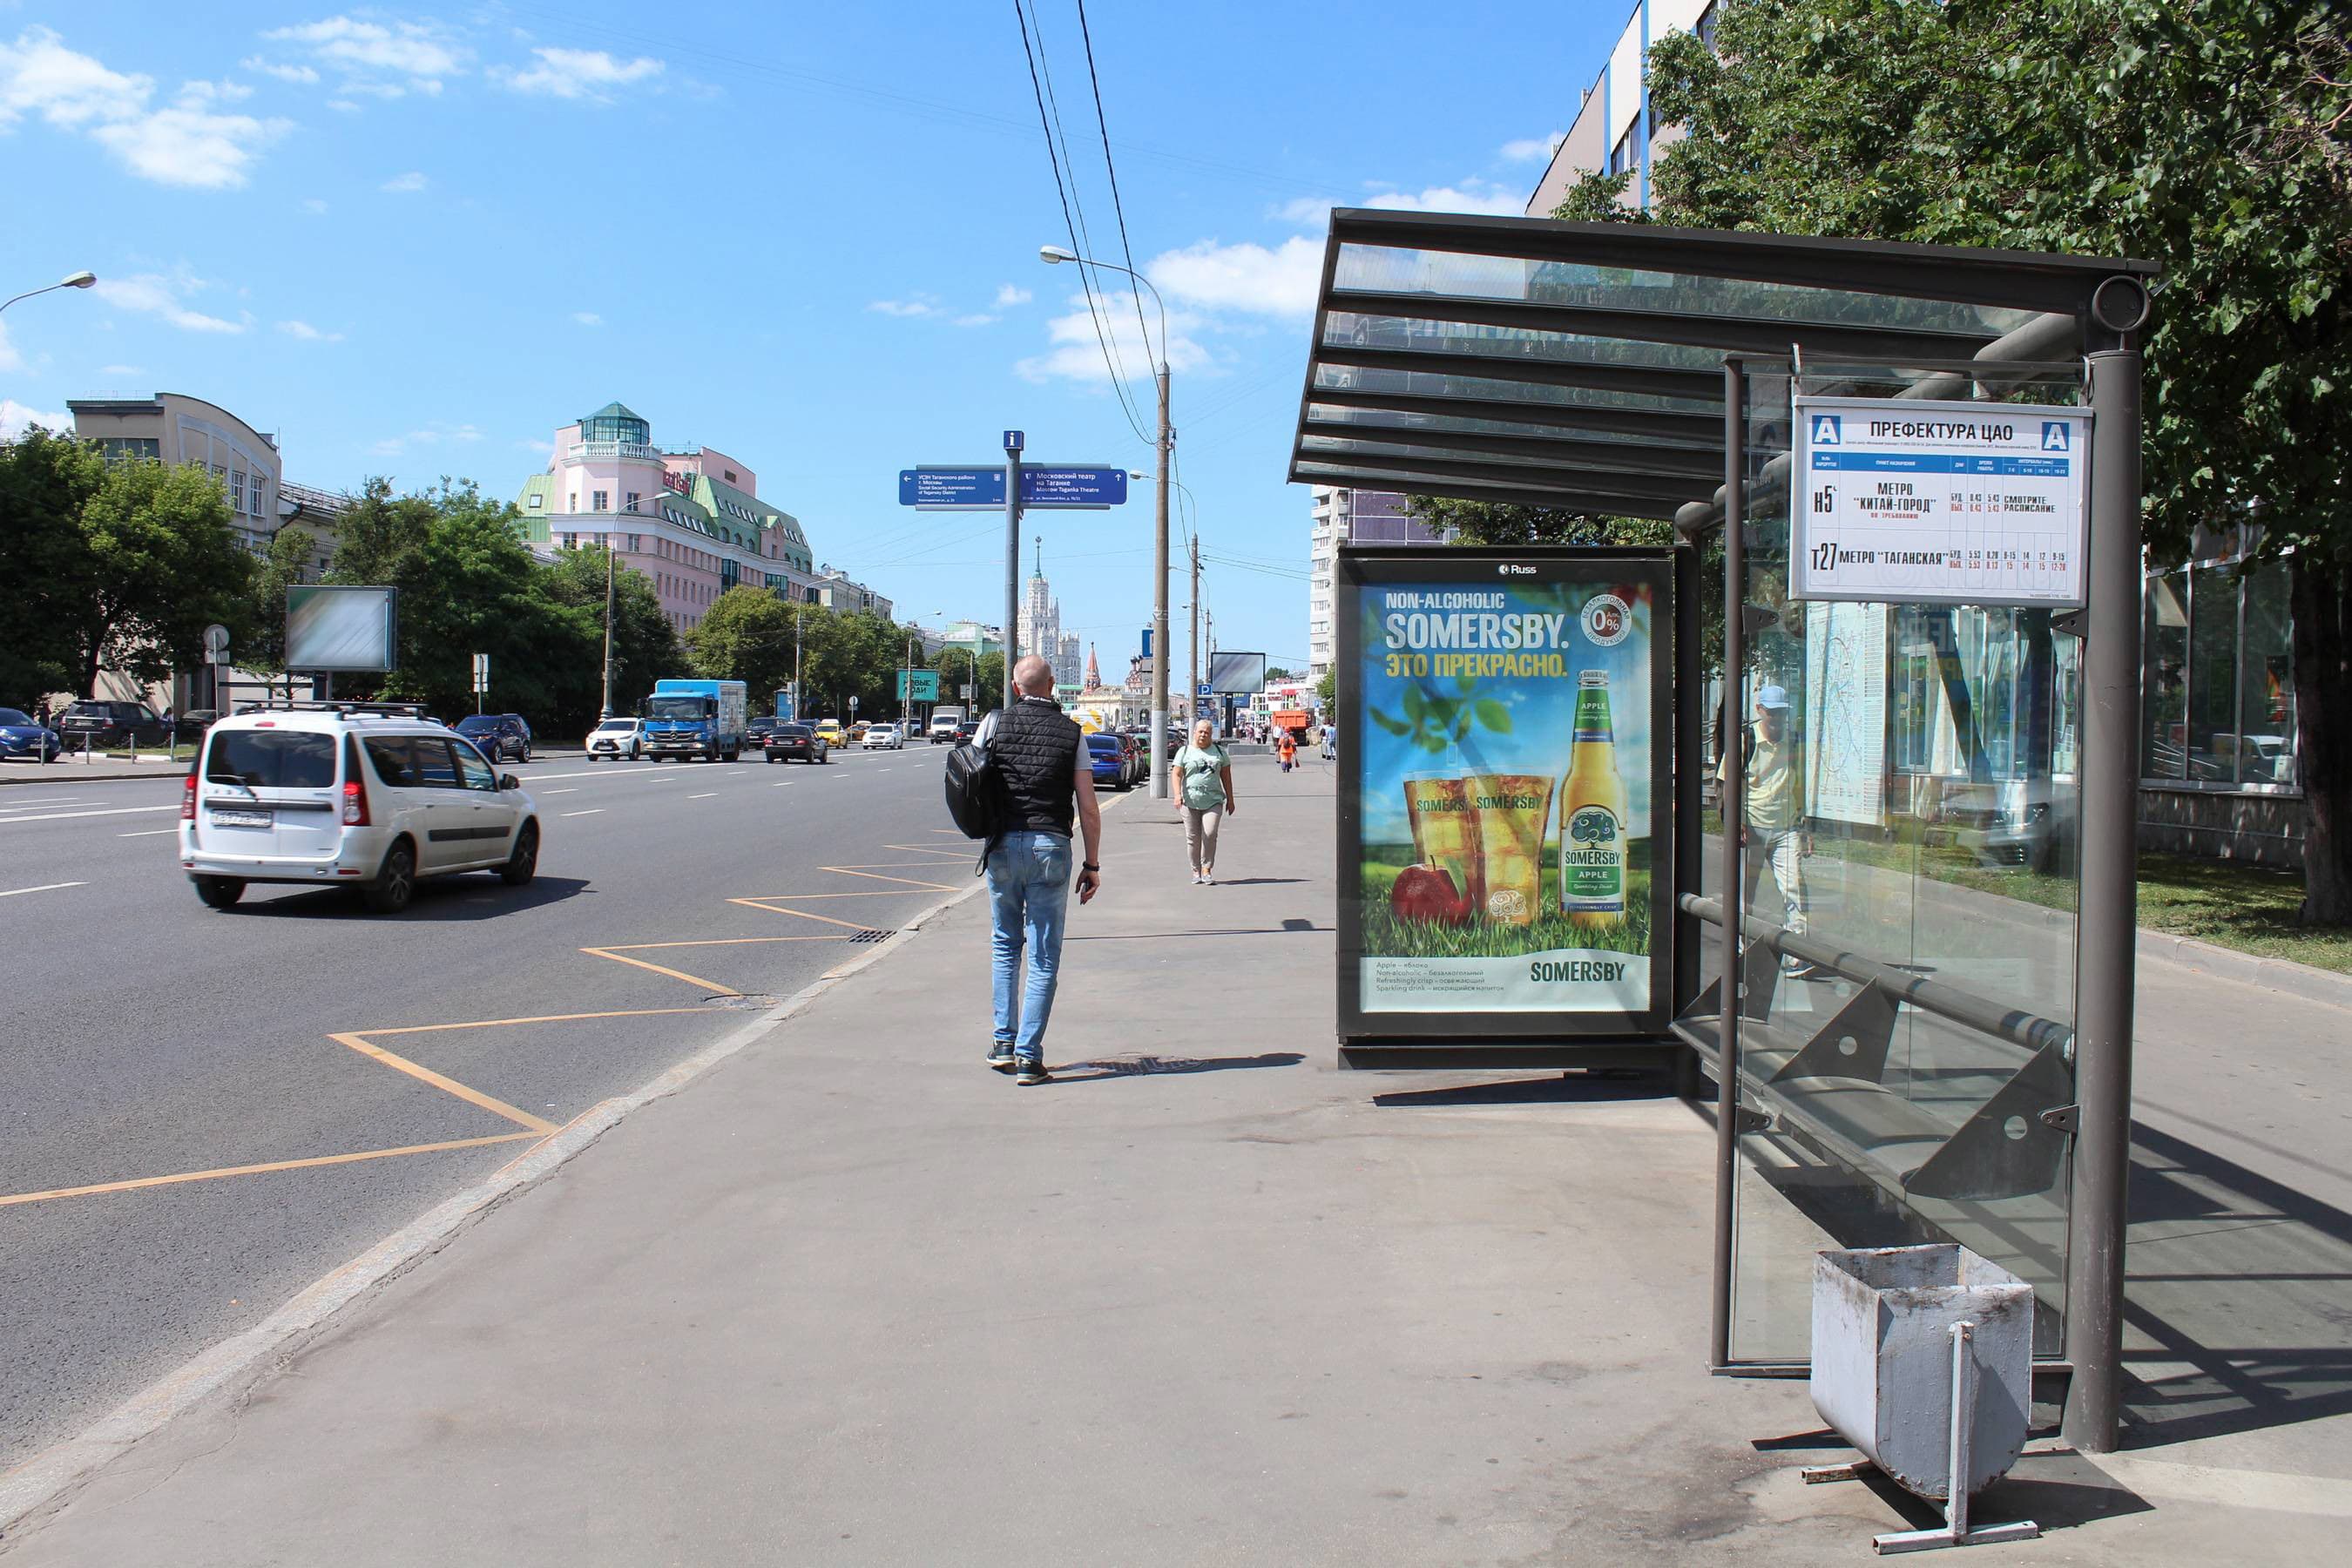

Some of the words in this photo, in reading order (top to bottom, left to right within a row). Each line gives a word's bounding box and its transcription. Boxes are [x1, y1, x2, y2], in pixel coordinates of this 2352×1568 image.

[1870, 422, 1977, 439] ПРЕФЕКТУРА
[1982, 424, 2013, 443] ЦАО
[1878, 483, 1913, 496] МЕТРО
[1815, 485, 1833, 513] Н5
[2004, 496, 2047, 504] СМОТРИТЕ
[2004, 504, 2057, 513] РАСПИСАНИЕ
[1812, 543, 1837, 570] Т27
[1840, 551, 1875, 564] МЕТРО
[2023, 551, 2030, 560] 14
[1511, 564, 1538, 574] Russ
[2023, 562, 2029, 571] 14
[1386, 593, 1505, 609] NON-ALCOHOLIC
[1386, 613, 1569, 649] SOMERSBY.
[1386, 654, 1428, 677] ЭТО
[1435, 654, 1568, 677] ПРЕКРАСНО.
[1477, 795, 1544, 809] SOMERSBY
[1565, 850, 1620, 864] SOMERSBY
[1531, 961, 1625, 982] SOMERSBY
